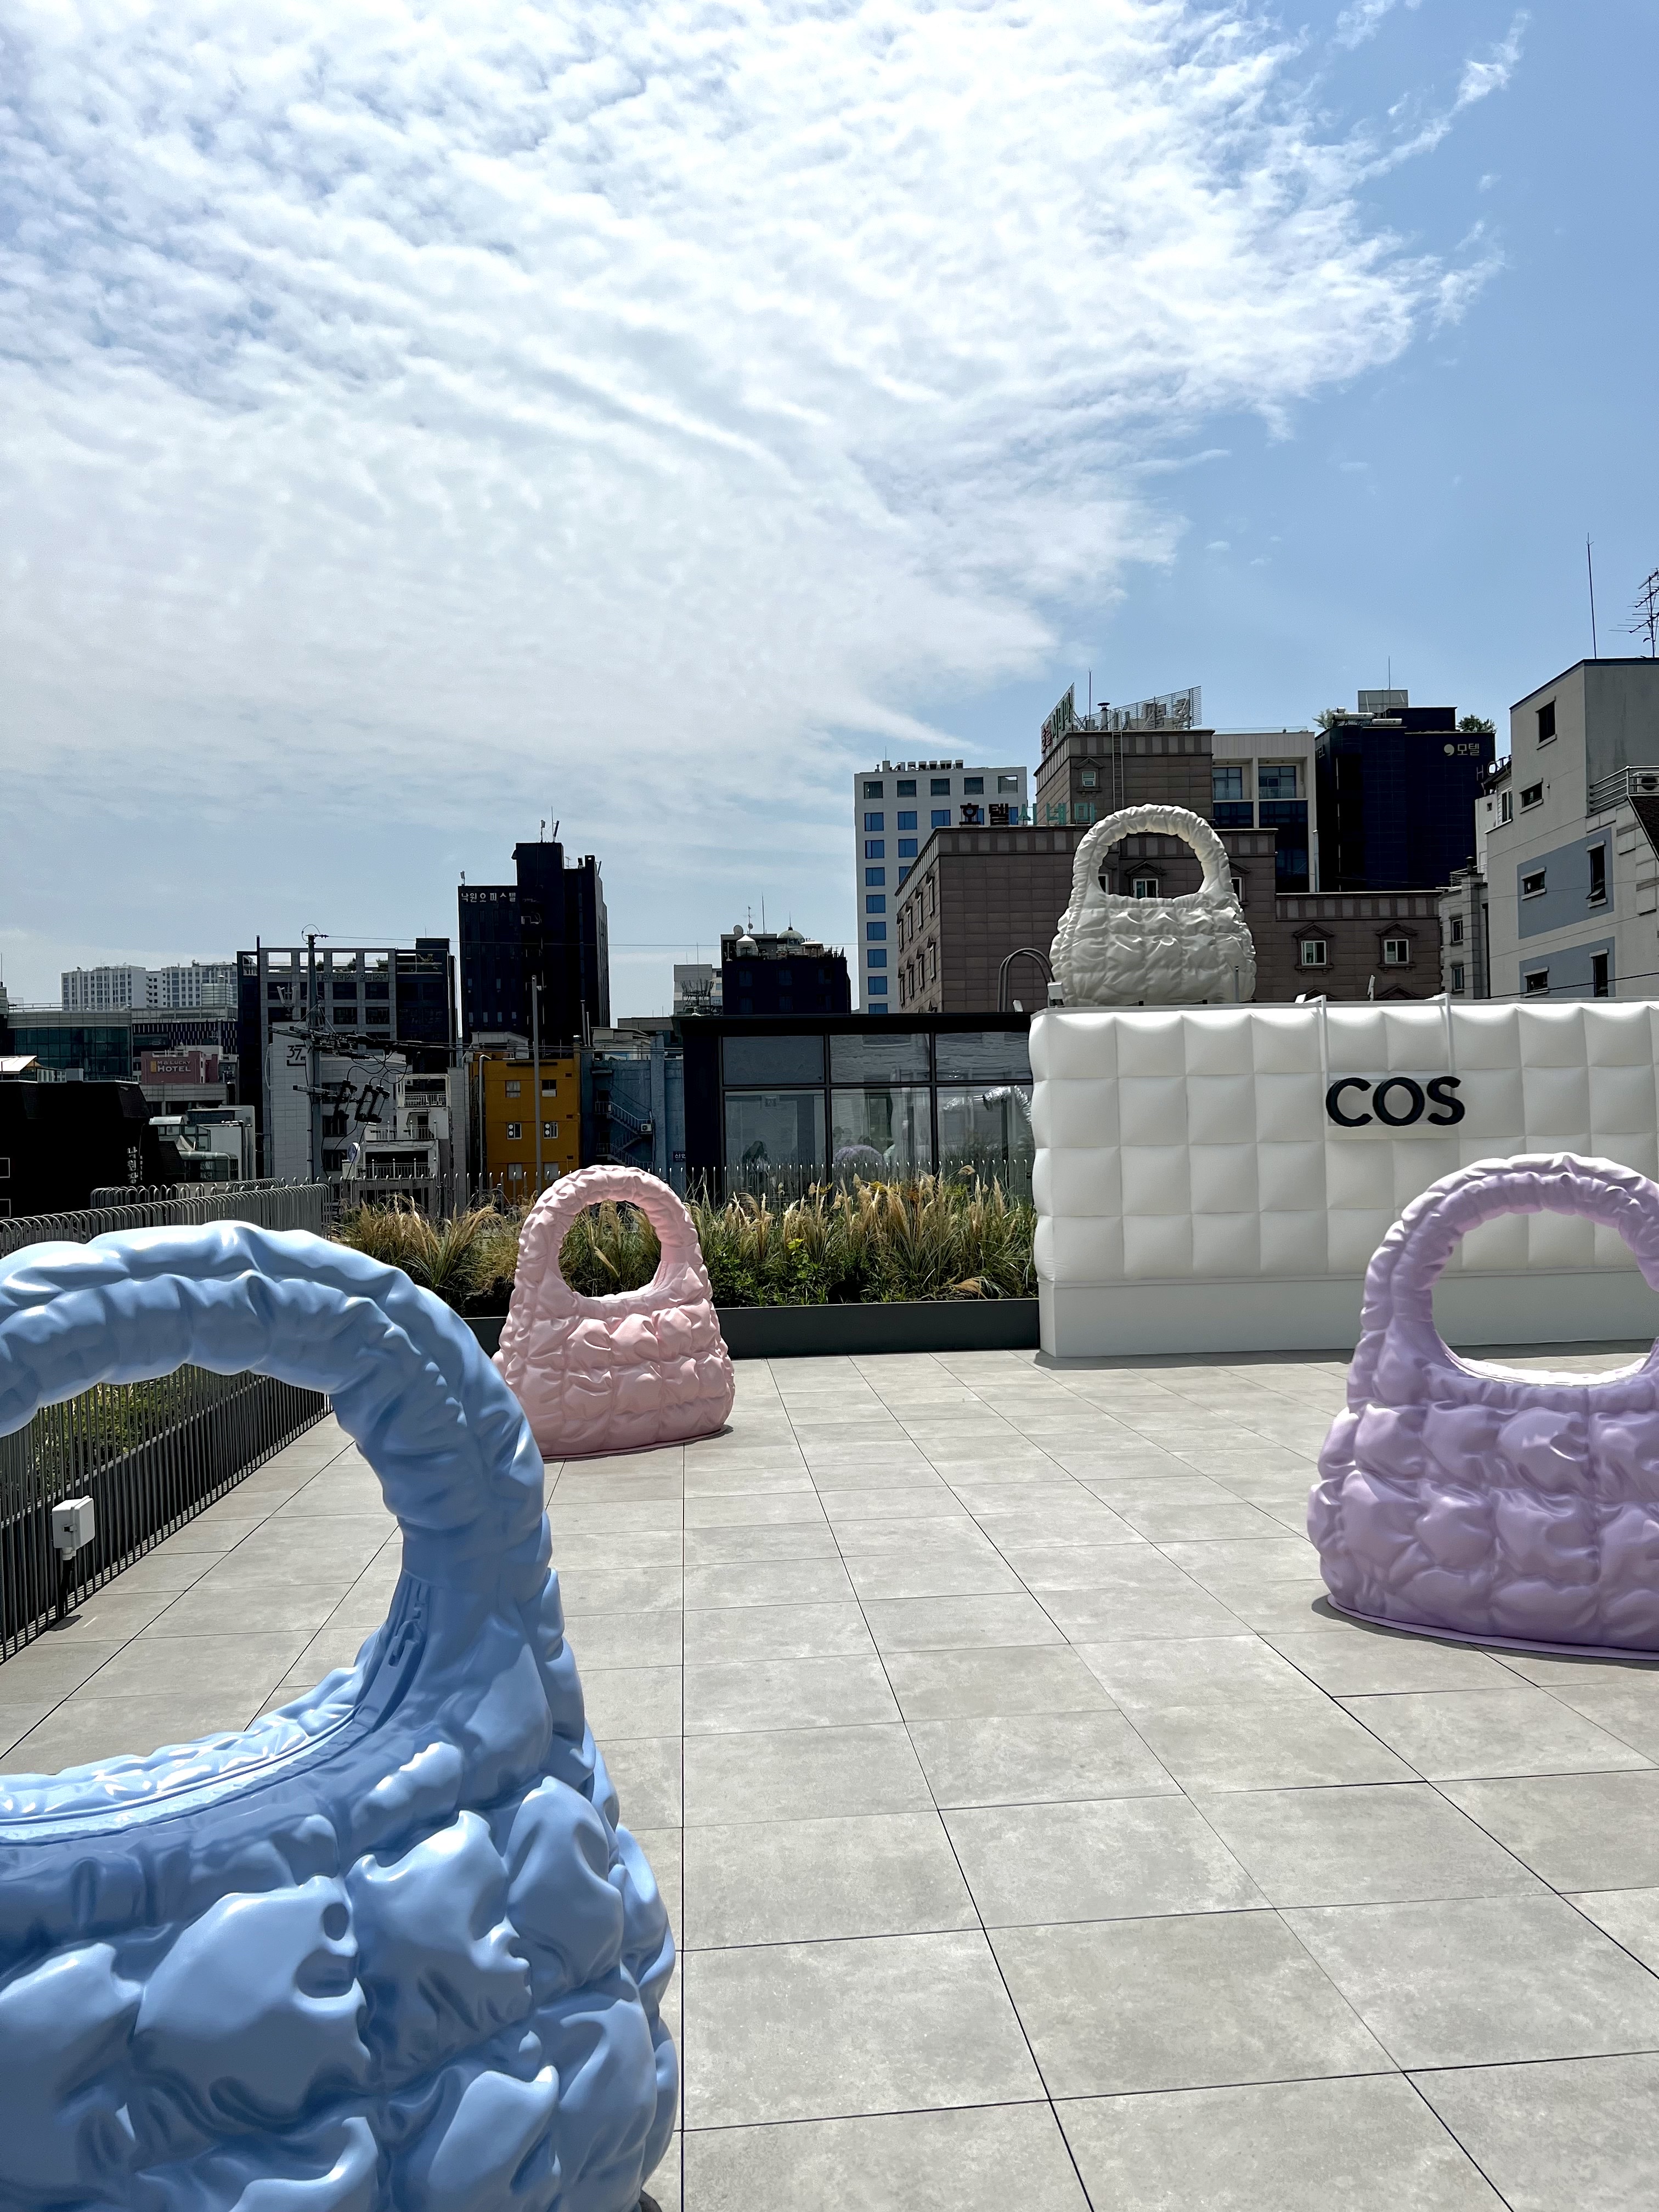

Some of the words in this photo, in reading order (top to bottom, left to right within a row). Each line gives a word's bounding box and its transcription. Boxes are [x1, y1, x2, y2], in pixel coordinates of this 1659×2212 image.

[1457, 743, 1480, 756] 모텔
[461, 893, 516, 903] 낙원오피스텔
[359, 973, 389, 983] 오피스텔
[1325, 1076, 1465, 1127] COS
